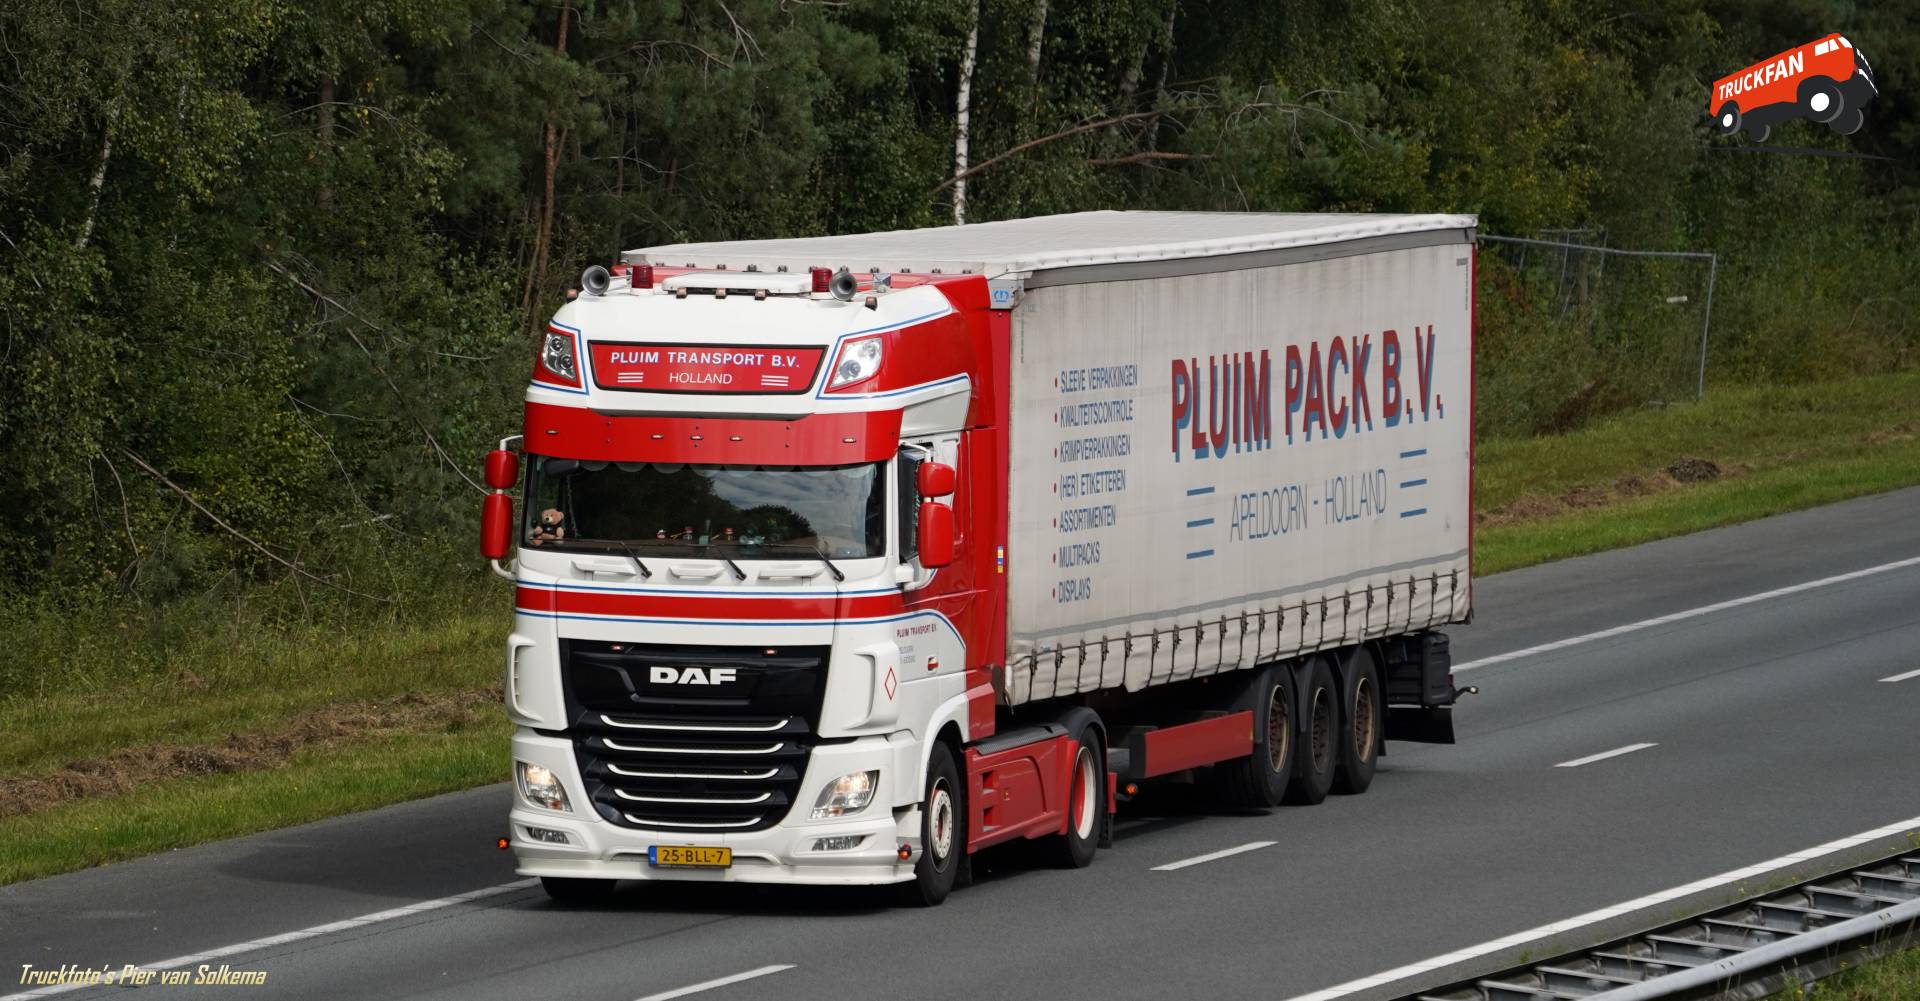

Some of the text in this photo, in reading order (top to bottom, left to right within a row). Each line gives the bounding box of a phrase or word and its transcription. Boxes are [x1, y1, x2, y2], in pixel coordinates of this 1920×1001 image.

[610, 351, 800, 368] PLUIM TRANSPORT B.V.
[668, 372, 733, 385] HOLLAND
[1060, 364, 1139, 394] SLEEVE VERPAKKINGEN
[1171, 324, 1444, 462] PLUIM PACK B.V.
[1060, 399, 1134, 428] KWALITEITSCONTROLE
[1060, 435, 1131, 462] KRIMPVERPAKKINGEN
[1059, 469, 1127, 501] (HER) ETIKETTEREN
[1059, 504, 1117, 534] ASSORTIMENTEN
[1229, 483, 1309, 543] APELDOORN
[1324, 468, 1388, 526] HOLLAND
[1058, 540, 1101, 569] MULTIPACKS
[1058, 577, 1091, 604] DISPLAYS
[896, 628, 910, 638] PLUIM
[910, 624, 931, 635] TRANSPORT
[650, 666, 737, 685] DAF
[662, 849, 724, 863] 25-BLL-7
